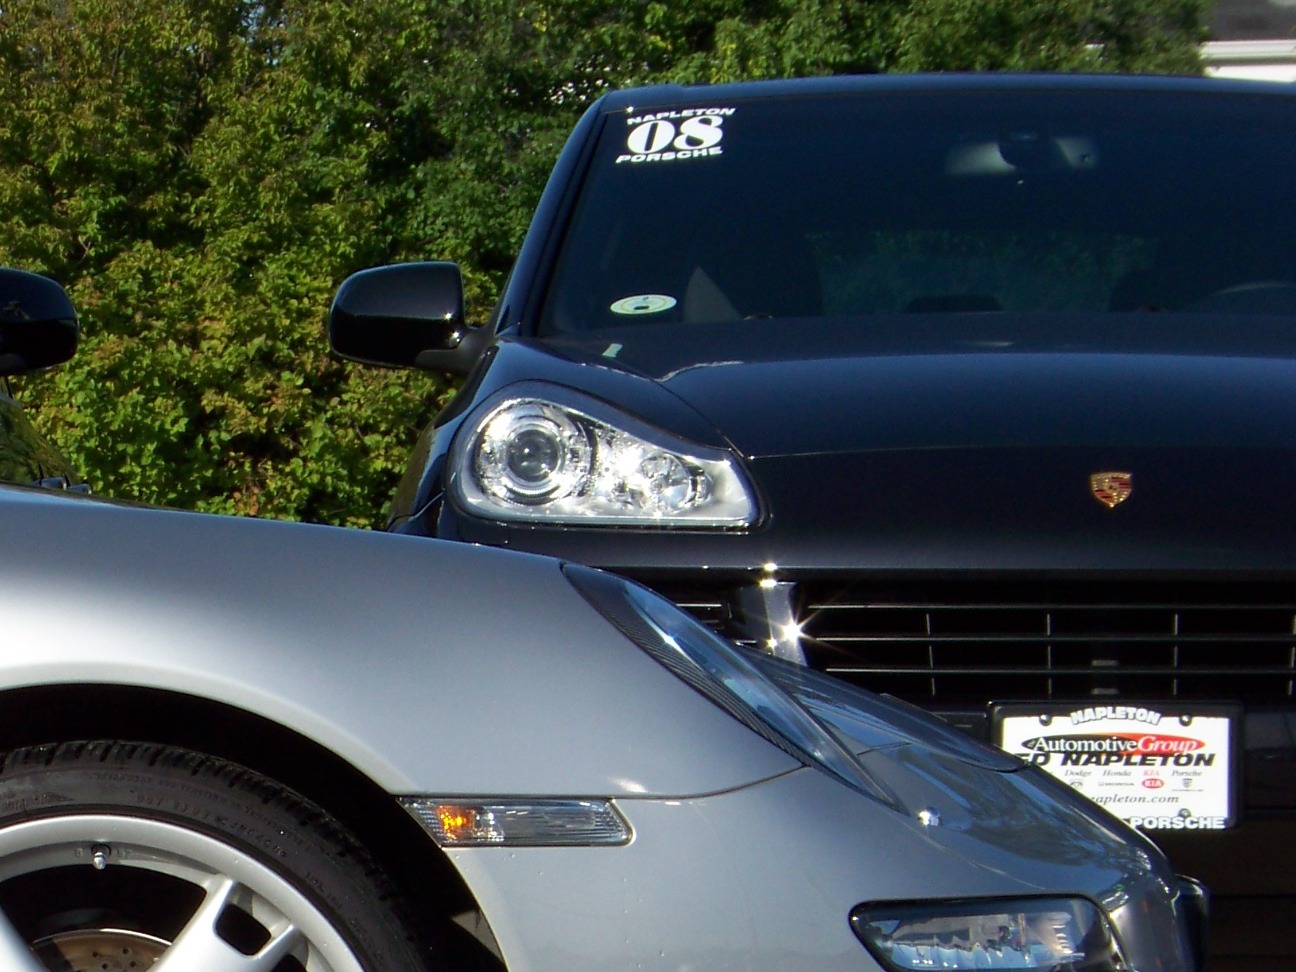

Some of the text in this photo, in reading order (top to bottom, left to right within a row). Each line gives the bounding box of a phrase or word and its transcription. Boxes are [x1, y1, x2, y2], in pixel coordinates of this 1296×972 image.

[626, 107, 736, 125] NAPLETON
[627, 115, 723, 153] 08
[615, 146, 723, 163] PORSCHE
[1070, 706, 1161, 726] NAPLETON
[1061, 753, 1215, 766] NAPLETON
[1171, 769, 1202, 777] Porsche
[1130, 816, 1226, 830] PORSCHE
